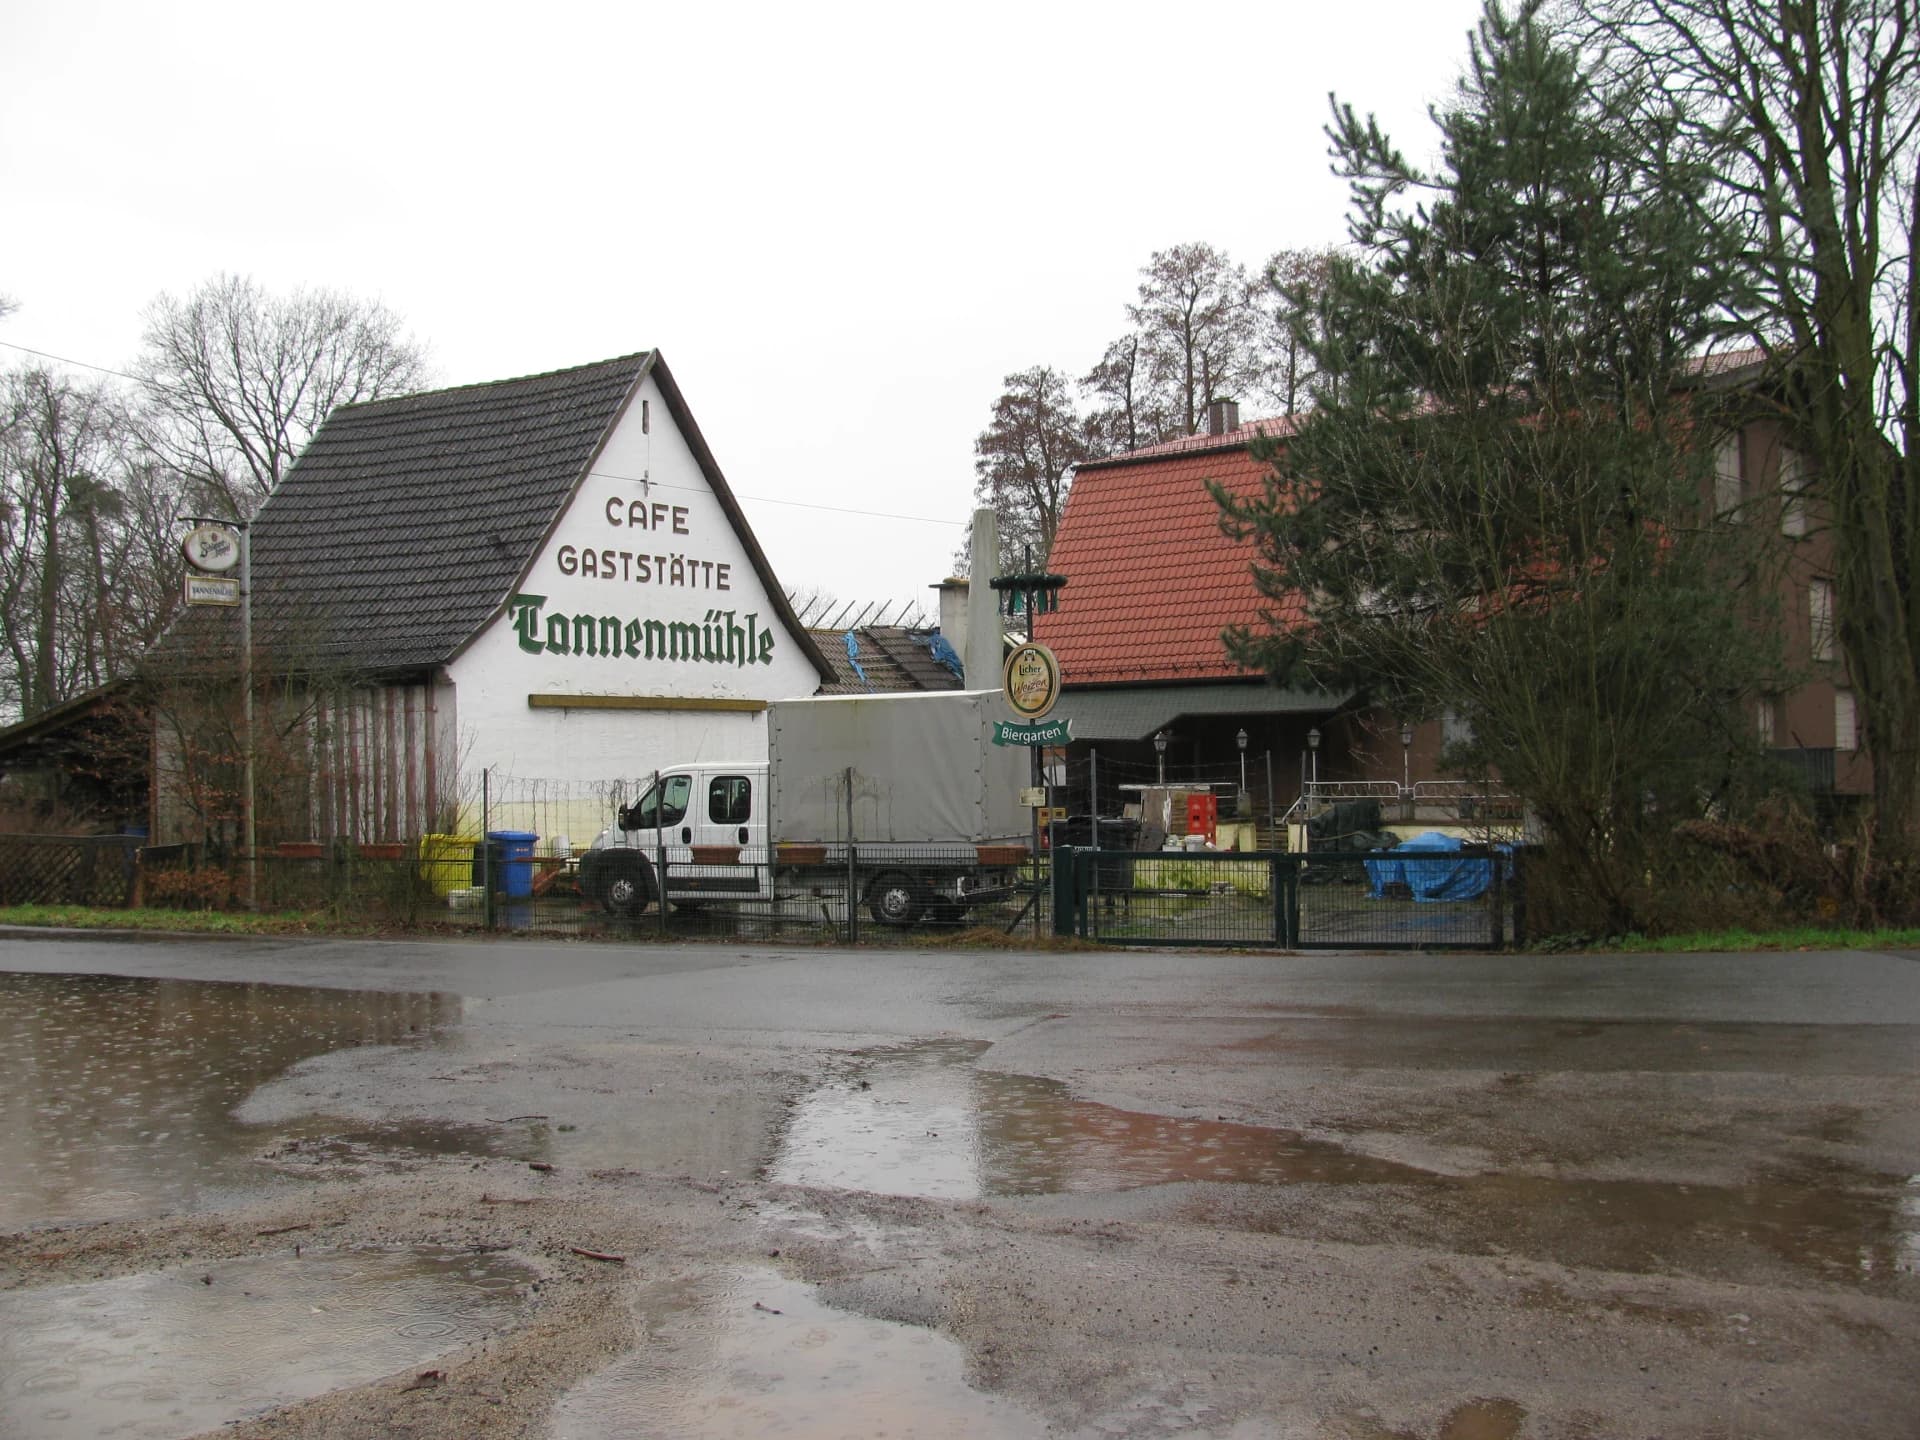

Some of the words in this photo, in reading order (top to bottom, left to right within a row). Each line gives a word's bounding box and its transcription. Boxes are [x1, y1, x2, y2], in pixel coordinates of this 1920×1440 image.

[605, 497, 690, 535] CAFE
[557, 545, 731, 590] GASTSTÄTTE
[509, 593, 775, 668] Tannenmühle
[1019, 664, 1041, 675] Licher
[1001, 727, 1061, 744] Biergarten
